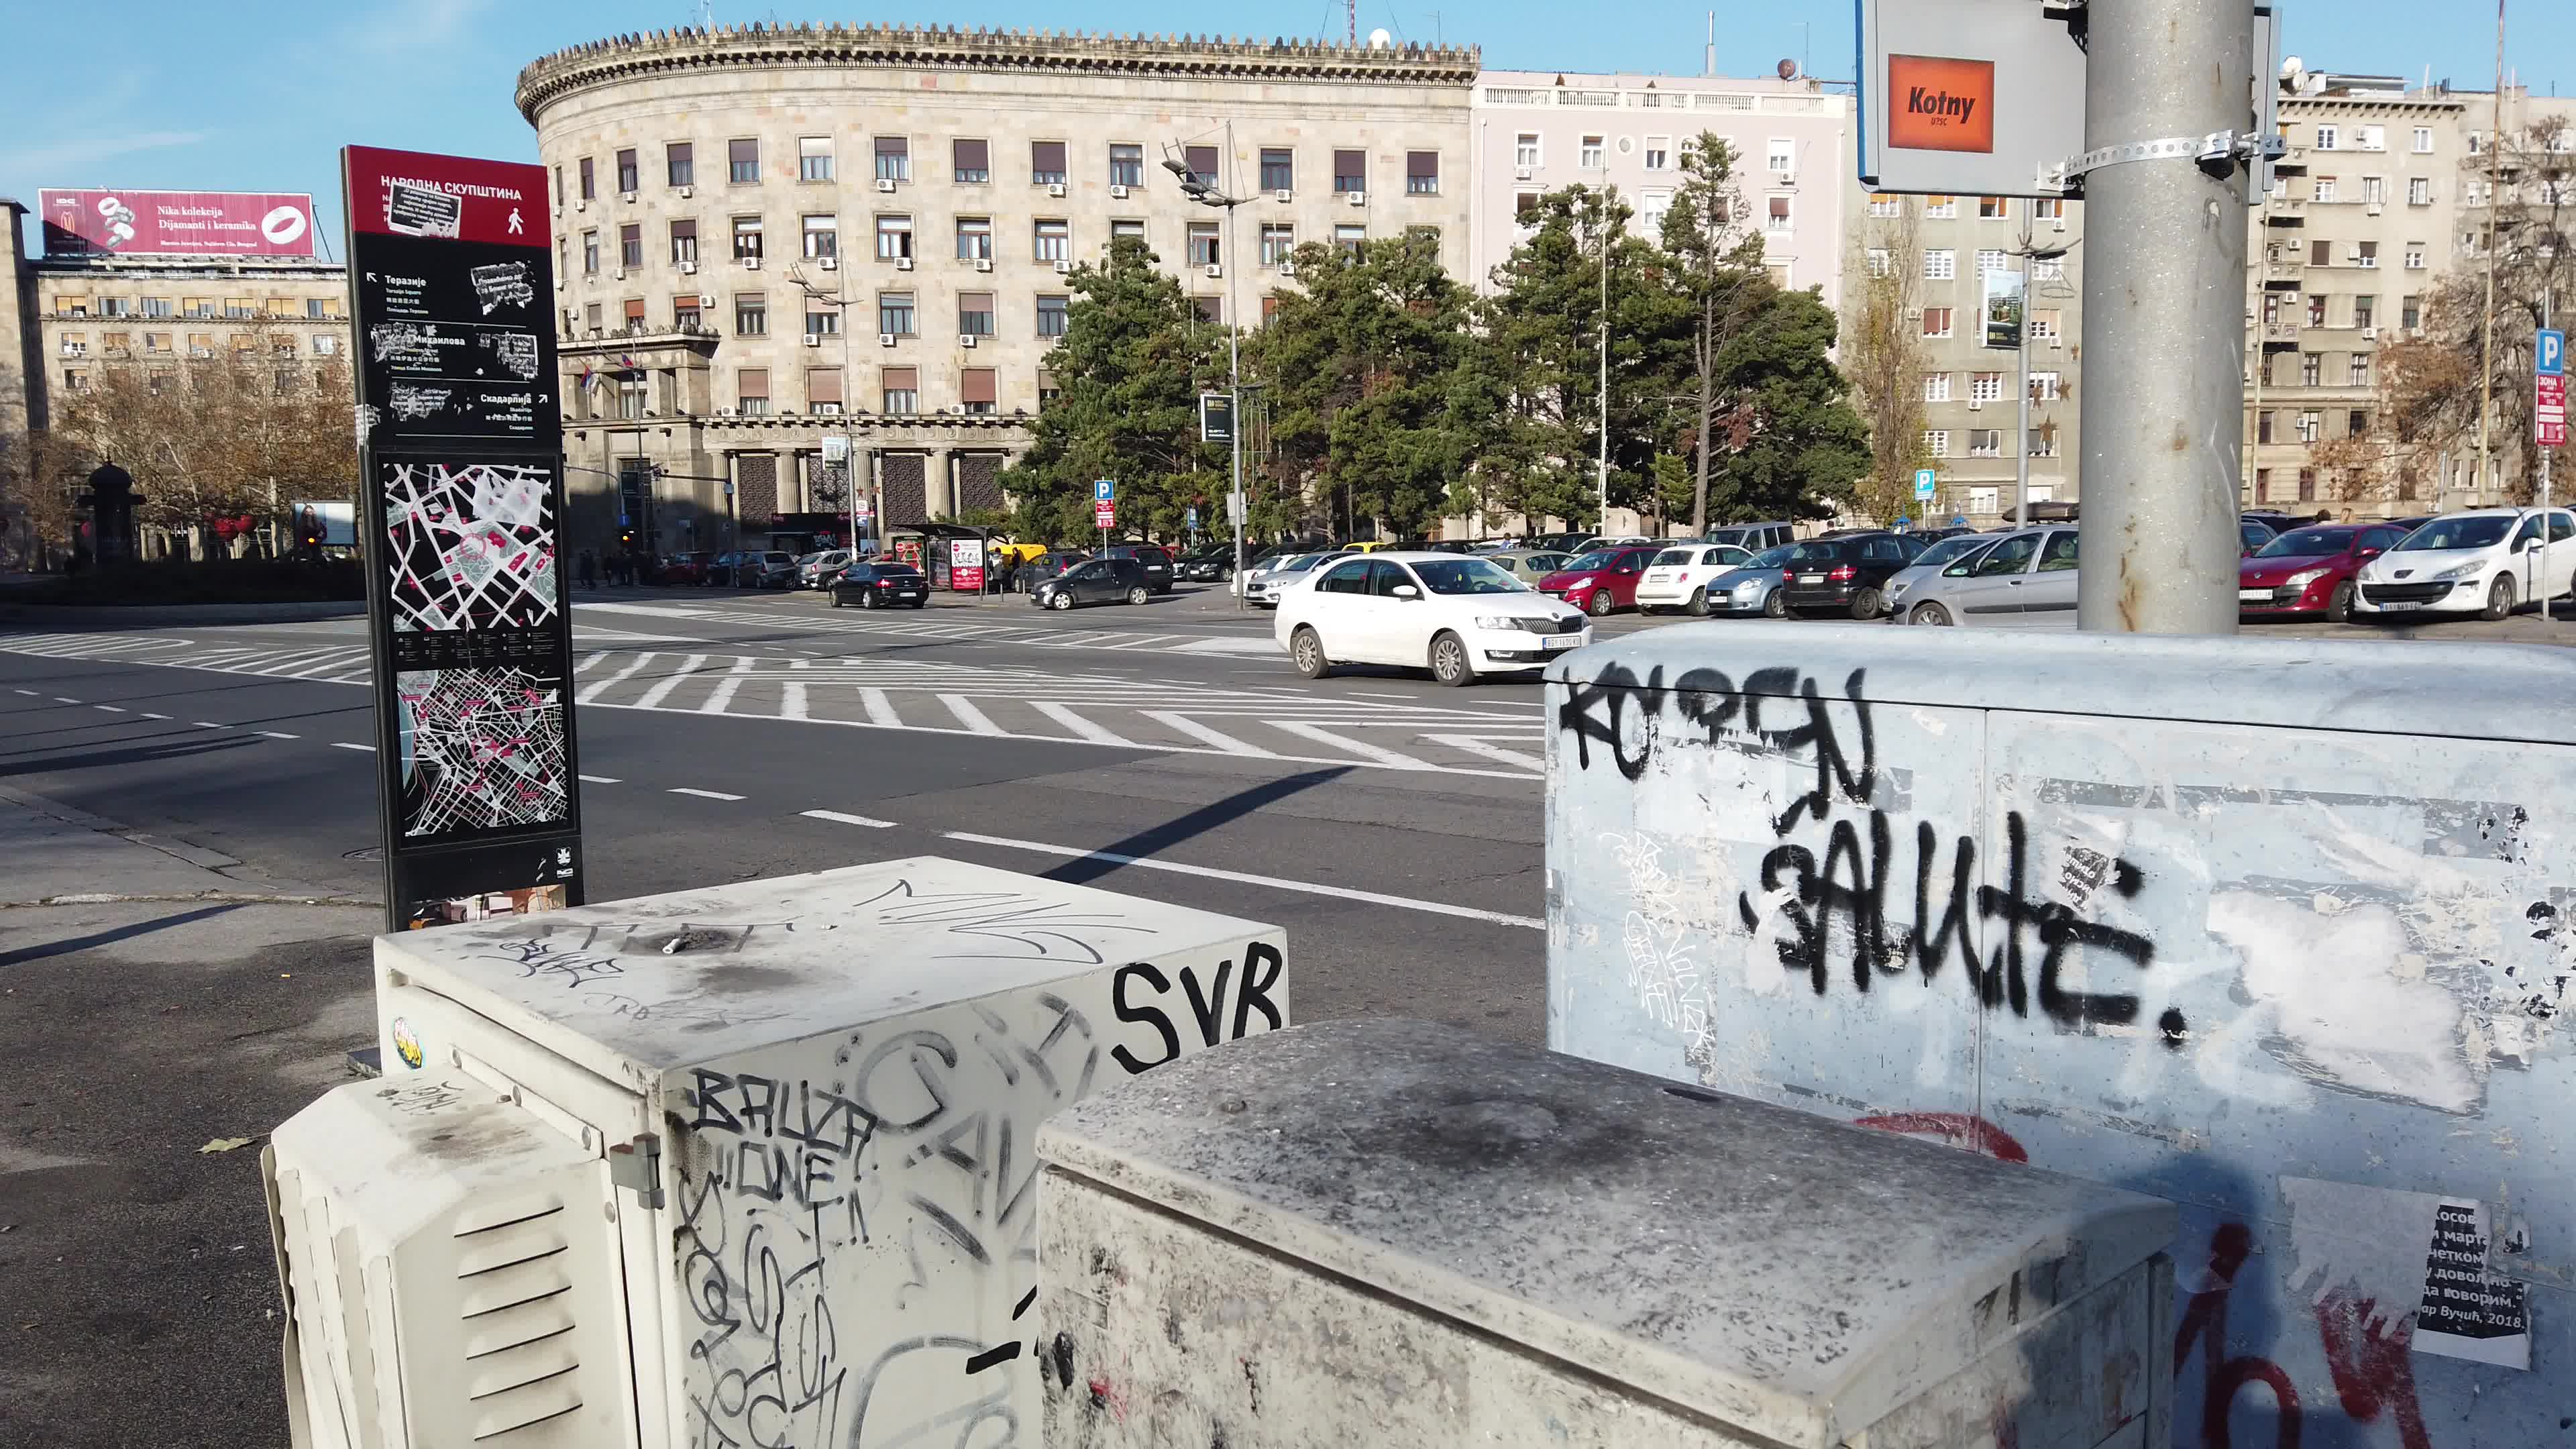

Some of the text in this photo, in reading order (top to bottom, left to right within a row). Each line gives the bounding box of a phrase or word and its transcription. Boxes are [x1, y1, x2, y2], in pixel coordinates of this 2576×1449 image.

[1908, 86, 1976, 124] Kotny
[445, 182, 523, 201] СКУПШТИНА
[157, 205, 223, 218] Nika kolekcija
[158, 219, 256, 231] Dijamanti i keramika
[384, 274, 427, 288] Теразије
[2544, 335, 2559, 366] P
[480, 393, 532, 405] Скадарлија
[1919, 472, 1931, 489] P
[1099, 482, 1110, 498] P
[1111, 941, 1283, 1074] SVR
[2441, 1305, 2483, 1324] Вучић,
[2487, 1312, 2525, 1330] 2018.
